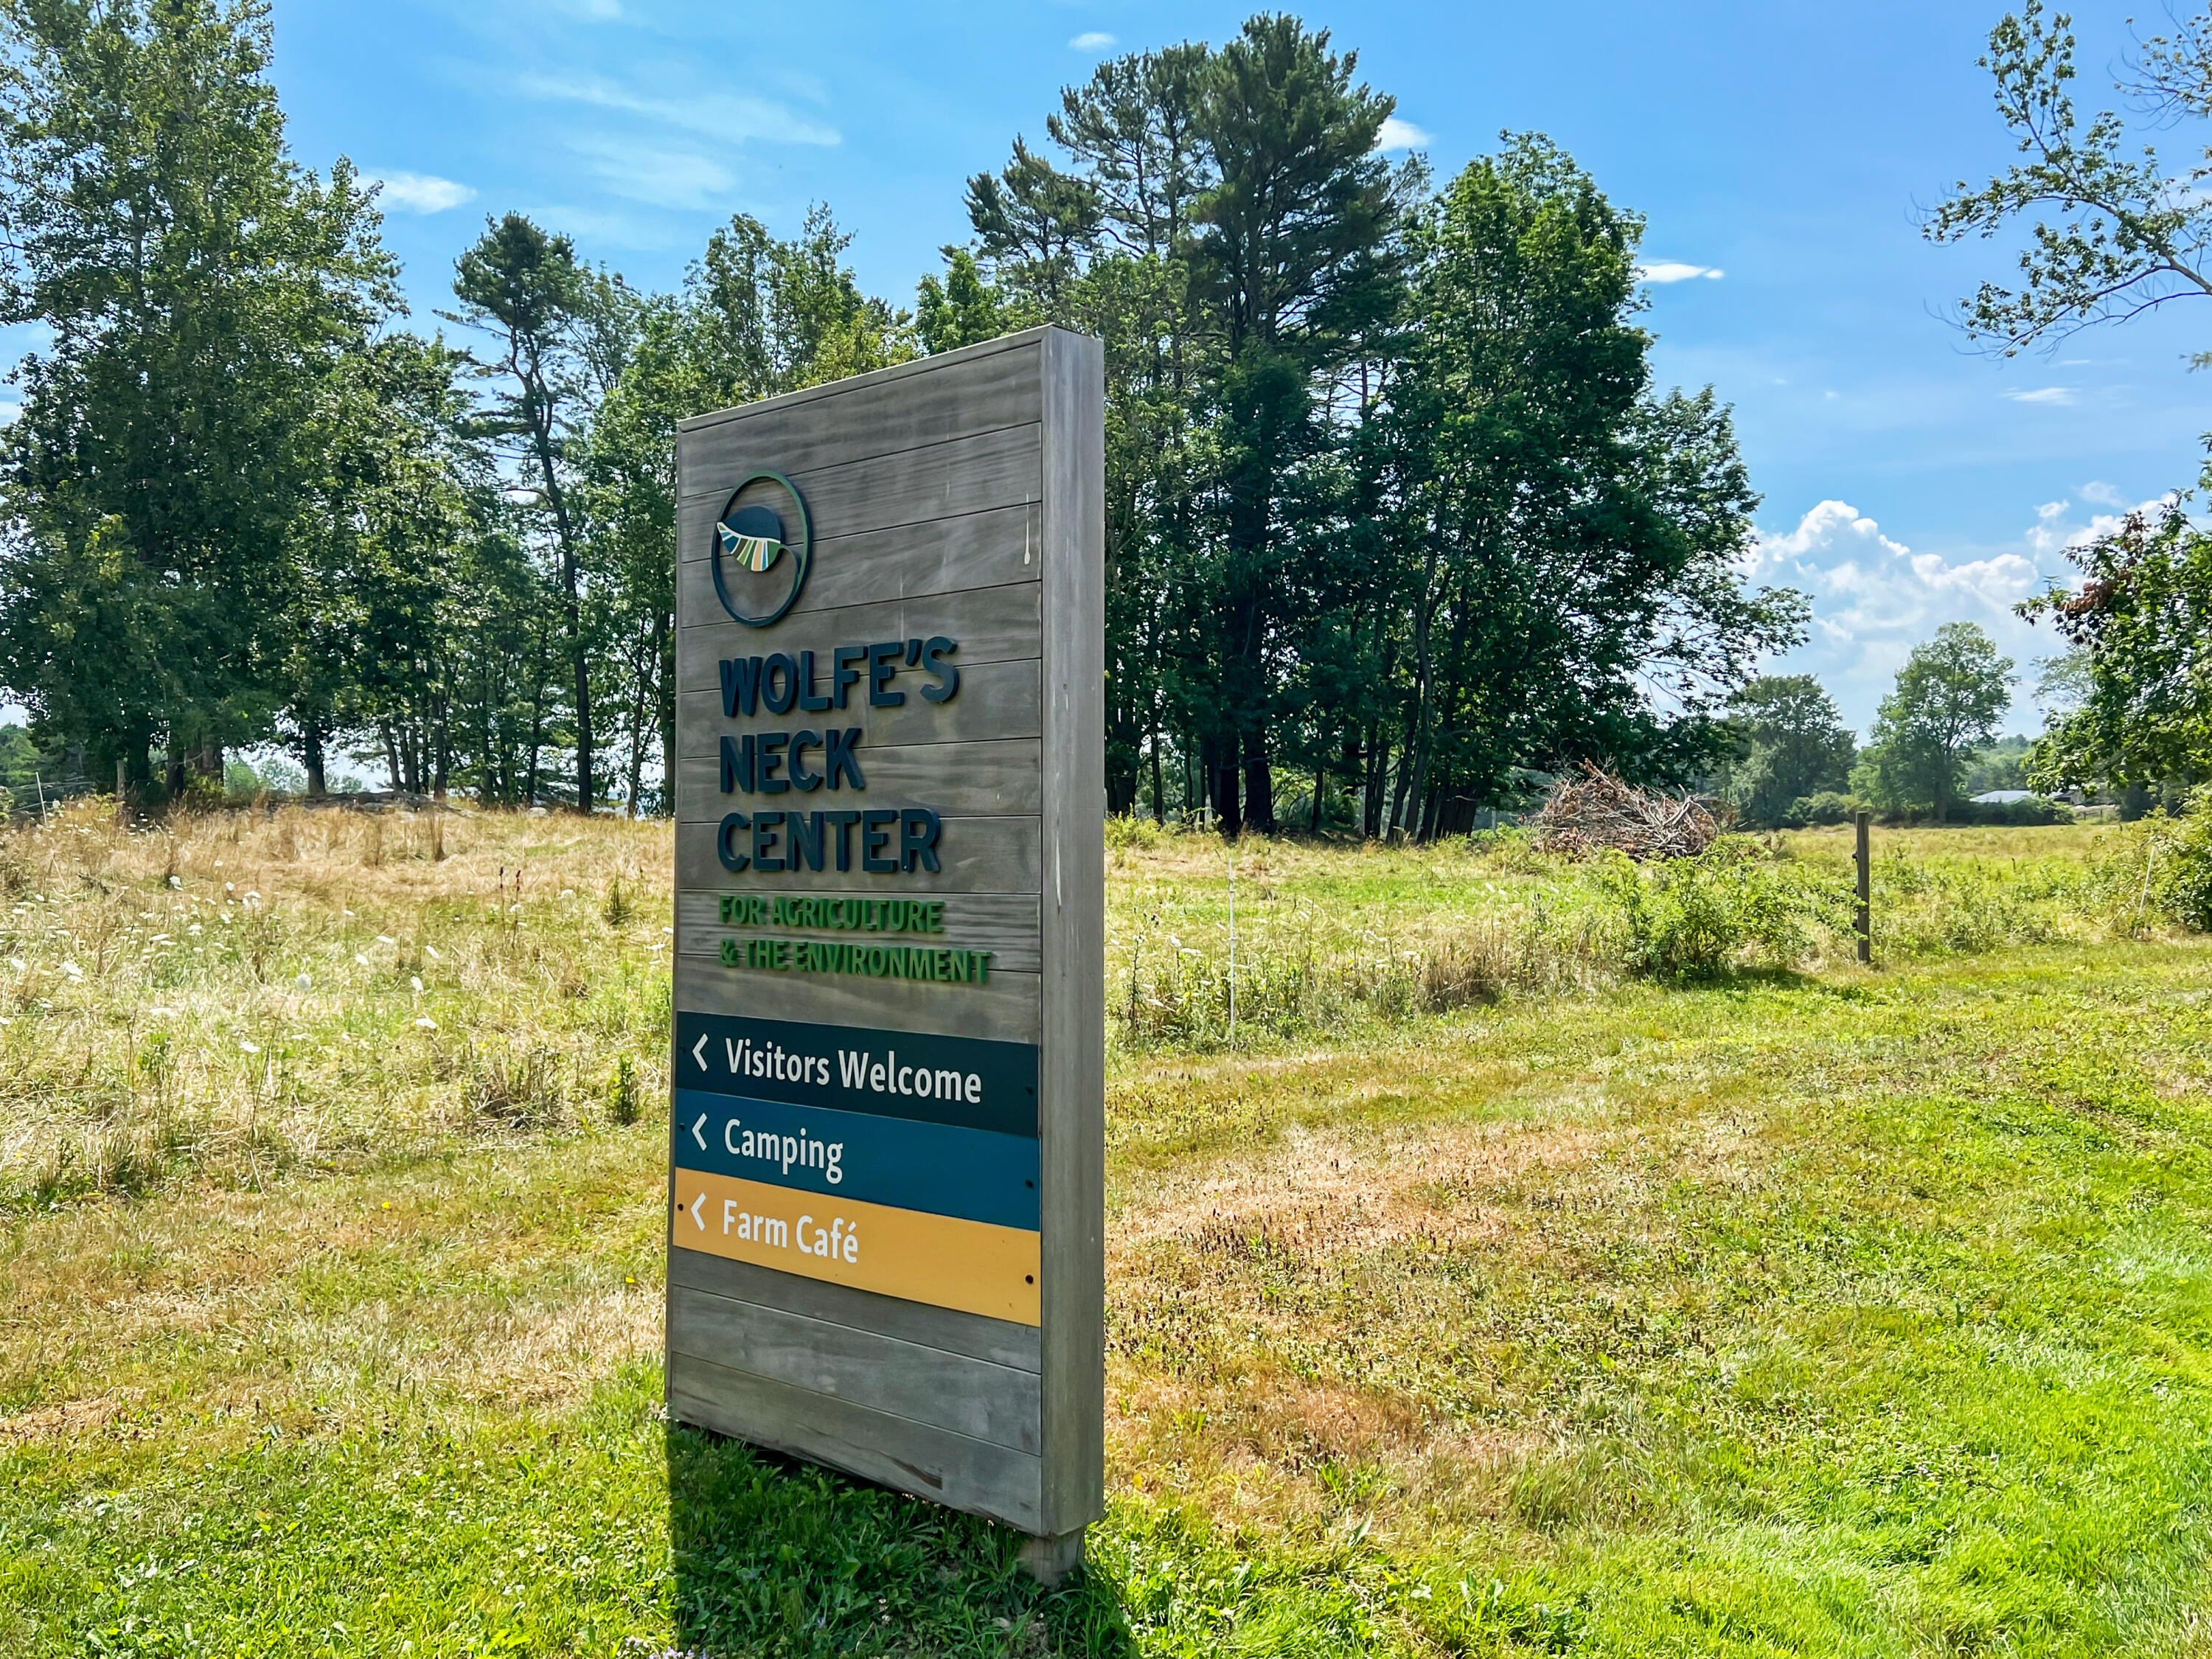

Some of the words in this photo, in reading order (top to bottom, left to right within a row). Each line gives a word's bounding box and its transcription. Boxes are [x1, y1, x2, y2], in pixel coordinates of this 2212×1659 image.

[719, 636, 959, 717] WOLFE'S
[720, 727, 866, 793] NECK
[717, 808, 941, 873] CENTER
[719, 894, 766, 924] FOR
[771, 896, 945, 933] AGRICULTURE
[719, 938, 738, 967] &
[742, 939, 789, 970] THE
[793, 941, 992, 984] ENVIRONMENT
[725, 1037, 830, 1085] Visitors
[838, 1049, 982, 1104] Welcome
[724, 1119, 844, 1184] Camping
[723, 1199, 787, 1248] Farm
[796, 1215, 859, 1264] Café
